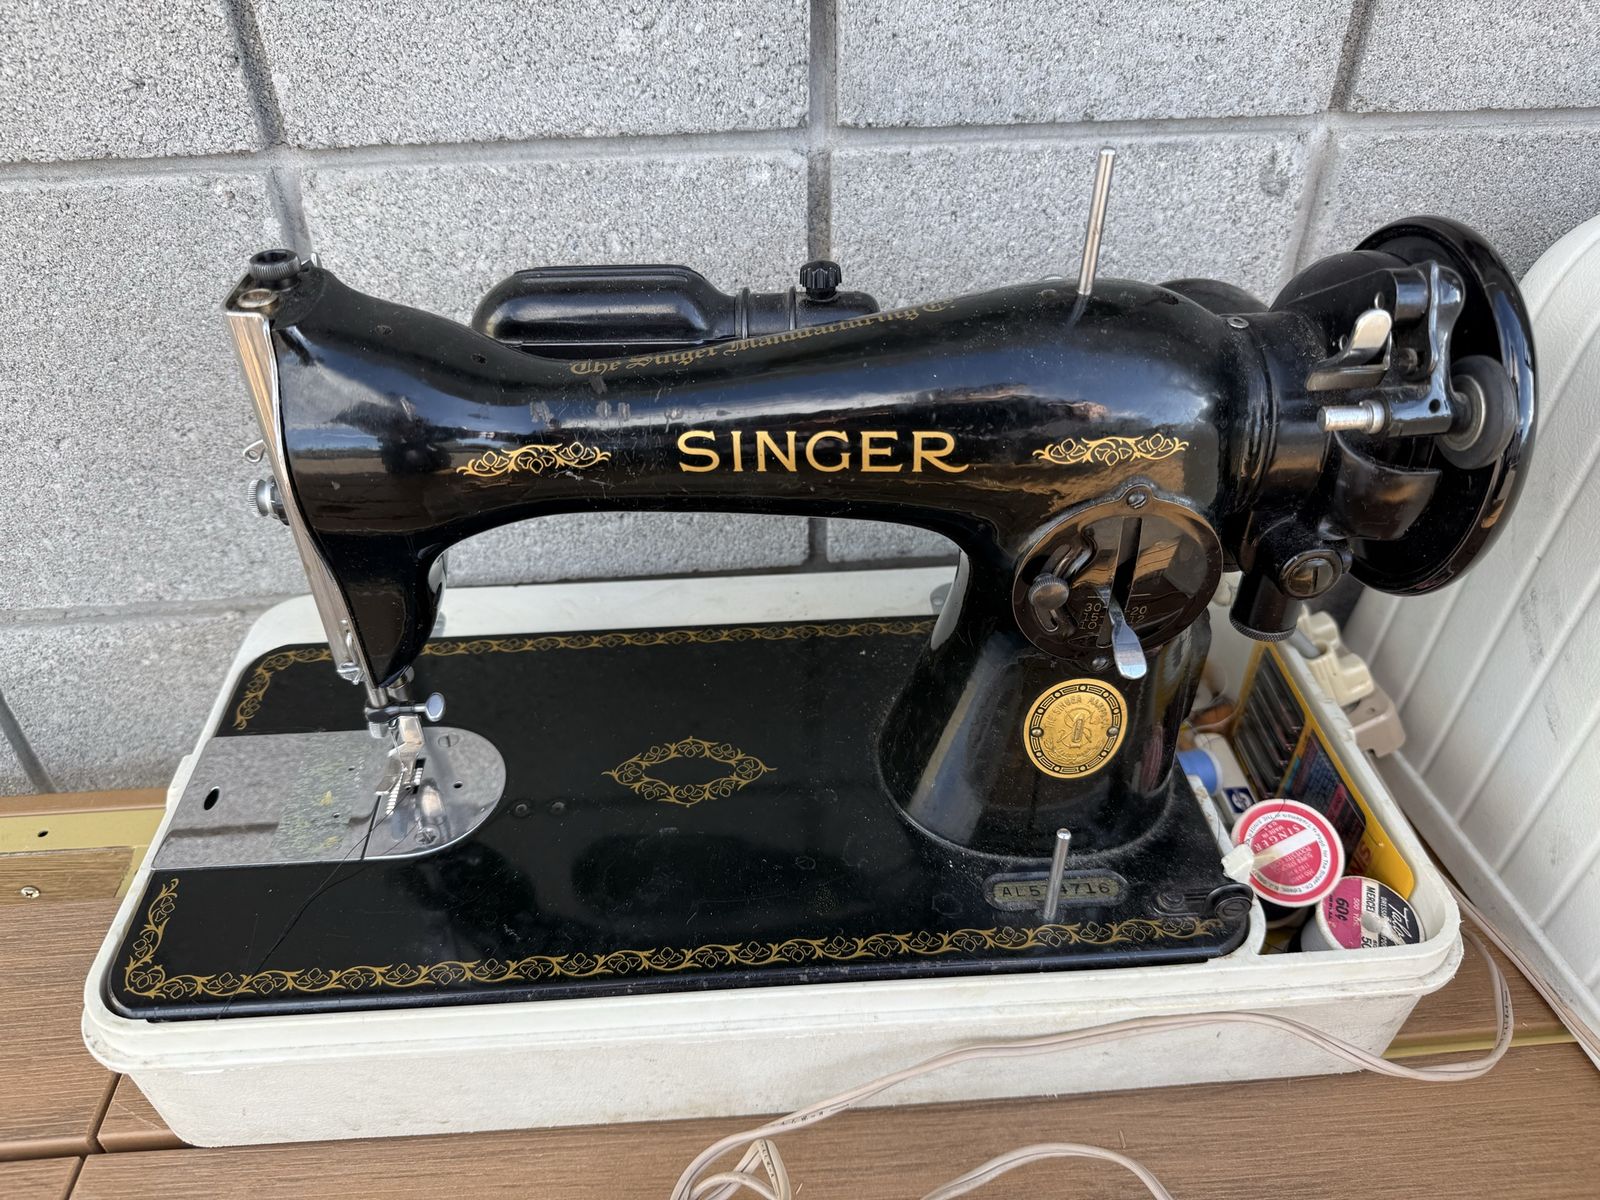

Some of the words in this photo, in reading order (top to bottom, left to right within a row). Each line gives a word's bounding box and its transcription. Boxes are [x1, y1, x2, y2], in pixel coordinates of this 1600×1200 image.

[570, 359, 621, 376] The
[626, 345, 717, 369] Singer
[677, 430, 970, 473] SINGER
[1083, 613, 1099, 621] 15
[1084, 603, 1102, 612] 30
[1130, 605, 1148, 616] 20
[1254, 823, 1300, 852] SINGER
[1002, 882, 1110, 898] AL54716
[1335, 897, 1349, 922] 60¢
